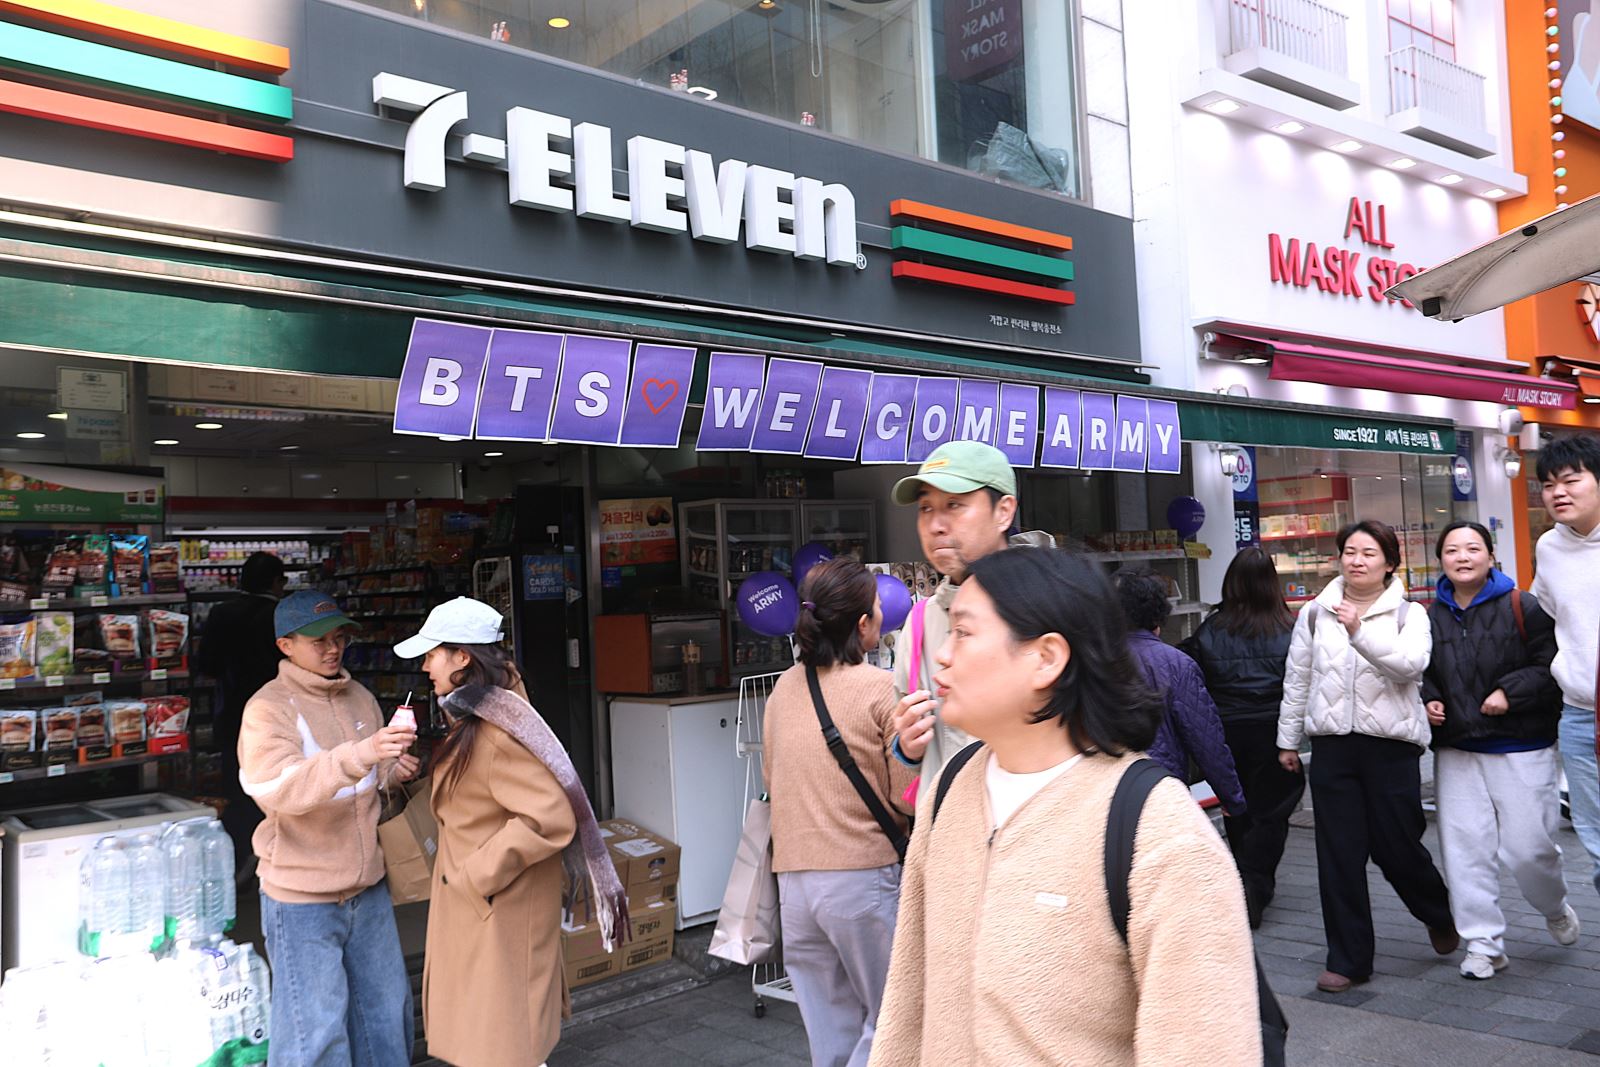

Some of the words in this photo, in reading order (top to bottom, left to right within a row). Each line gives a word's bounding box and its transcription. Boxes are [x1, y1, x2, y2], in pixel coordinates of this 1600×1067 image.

[1344, 196, 1395, 248] ALL
[1268, 233, 1362, 298] MASK
[1501, 387, 1516, 402] ALL
[1517, 388, 1540, 405] MASK
[1540, 391, 1562, 407] STORY
[713, 387, 1027, 447] WELCOME
[1056, 414, 1174, 456] ARMY
[529, 577, 556, 586] CARDS
[747, 584, 779, 603] Welcome
[753, 590, 783, 614] ARMY
